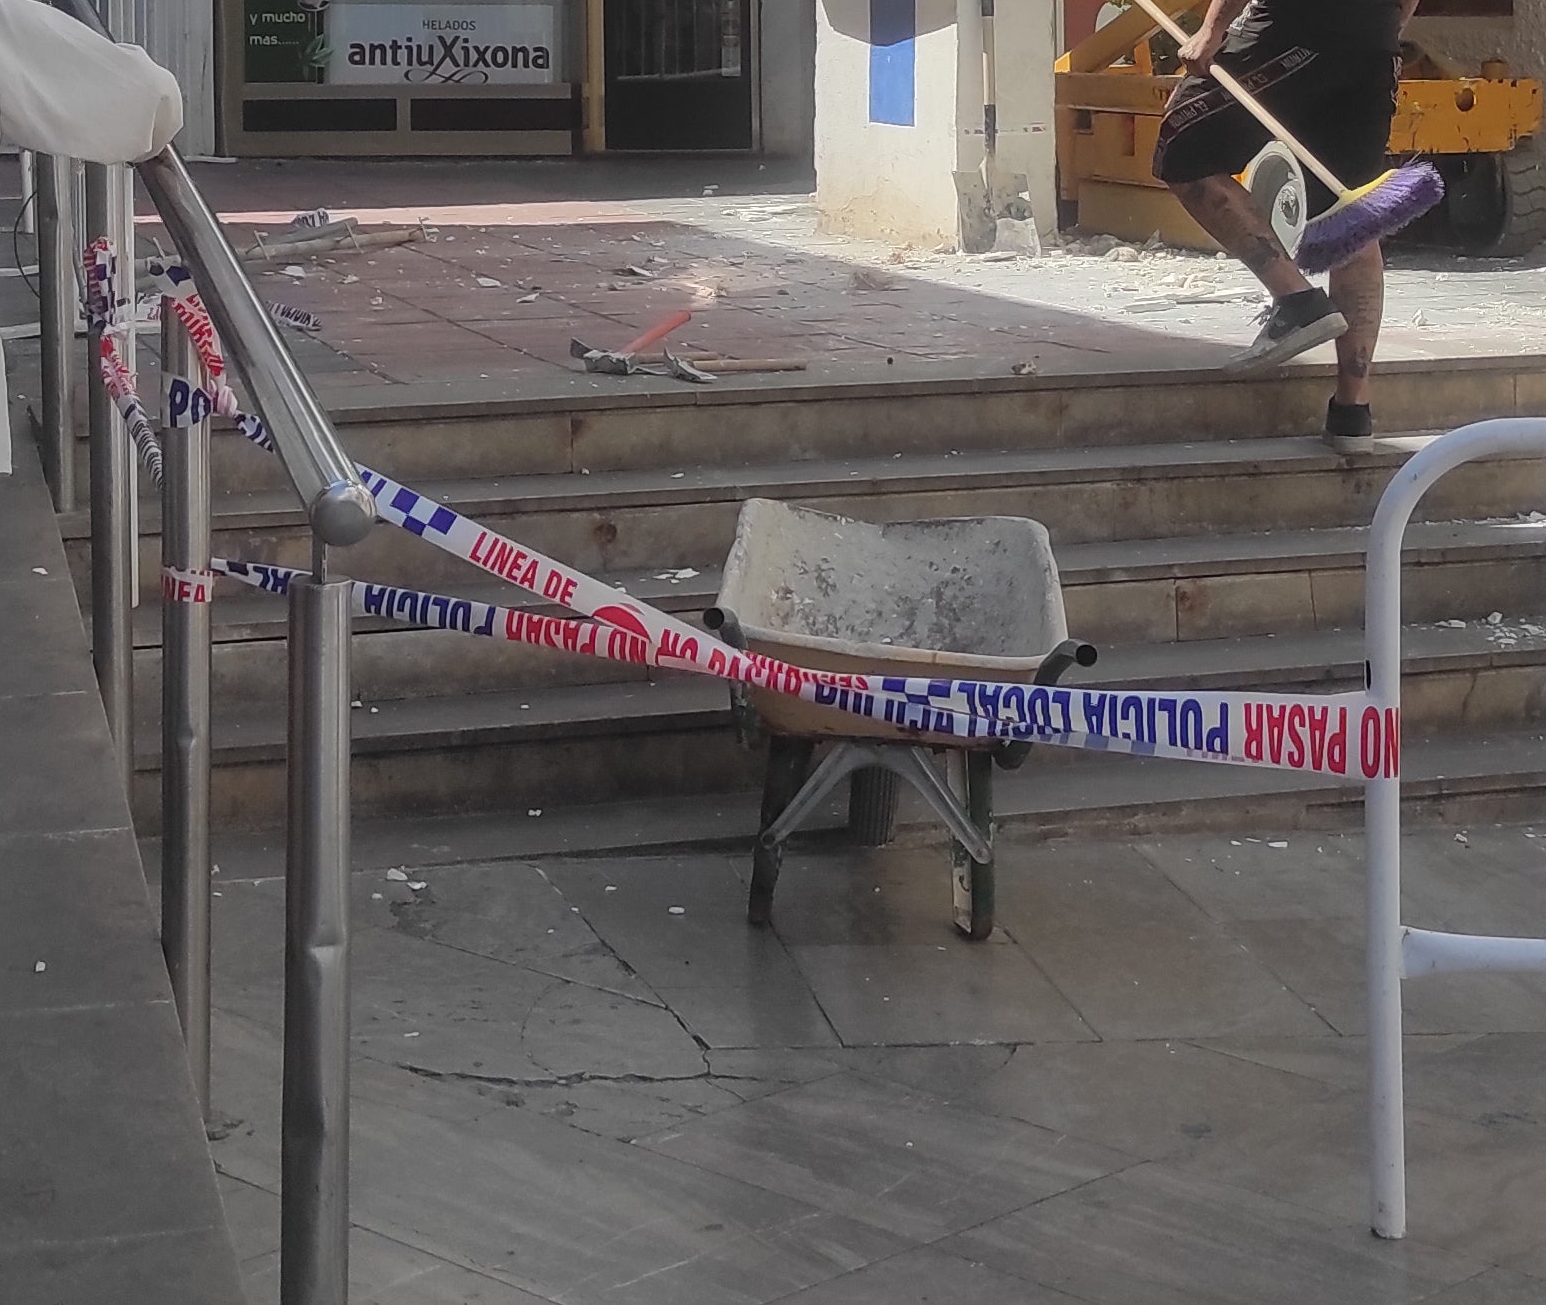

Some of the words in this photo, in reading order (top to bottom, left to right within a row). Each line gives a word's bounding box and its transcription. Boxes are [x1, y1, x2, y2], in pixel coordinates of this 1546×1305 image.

[249, 13, 259, 25] y
[262, 12, 306, 23] mucho
[422, 20, 476, 31] HELADOS
[469, 531, 539, 591] LINEA
[543, 568, 578, 607] DE
[1082, 689, 1229, 755] POLICIA
[1244, 702, 1348, 775] PASAR
[1359, 705, 1400, 780] NO
